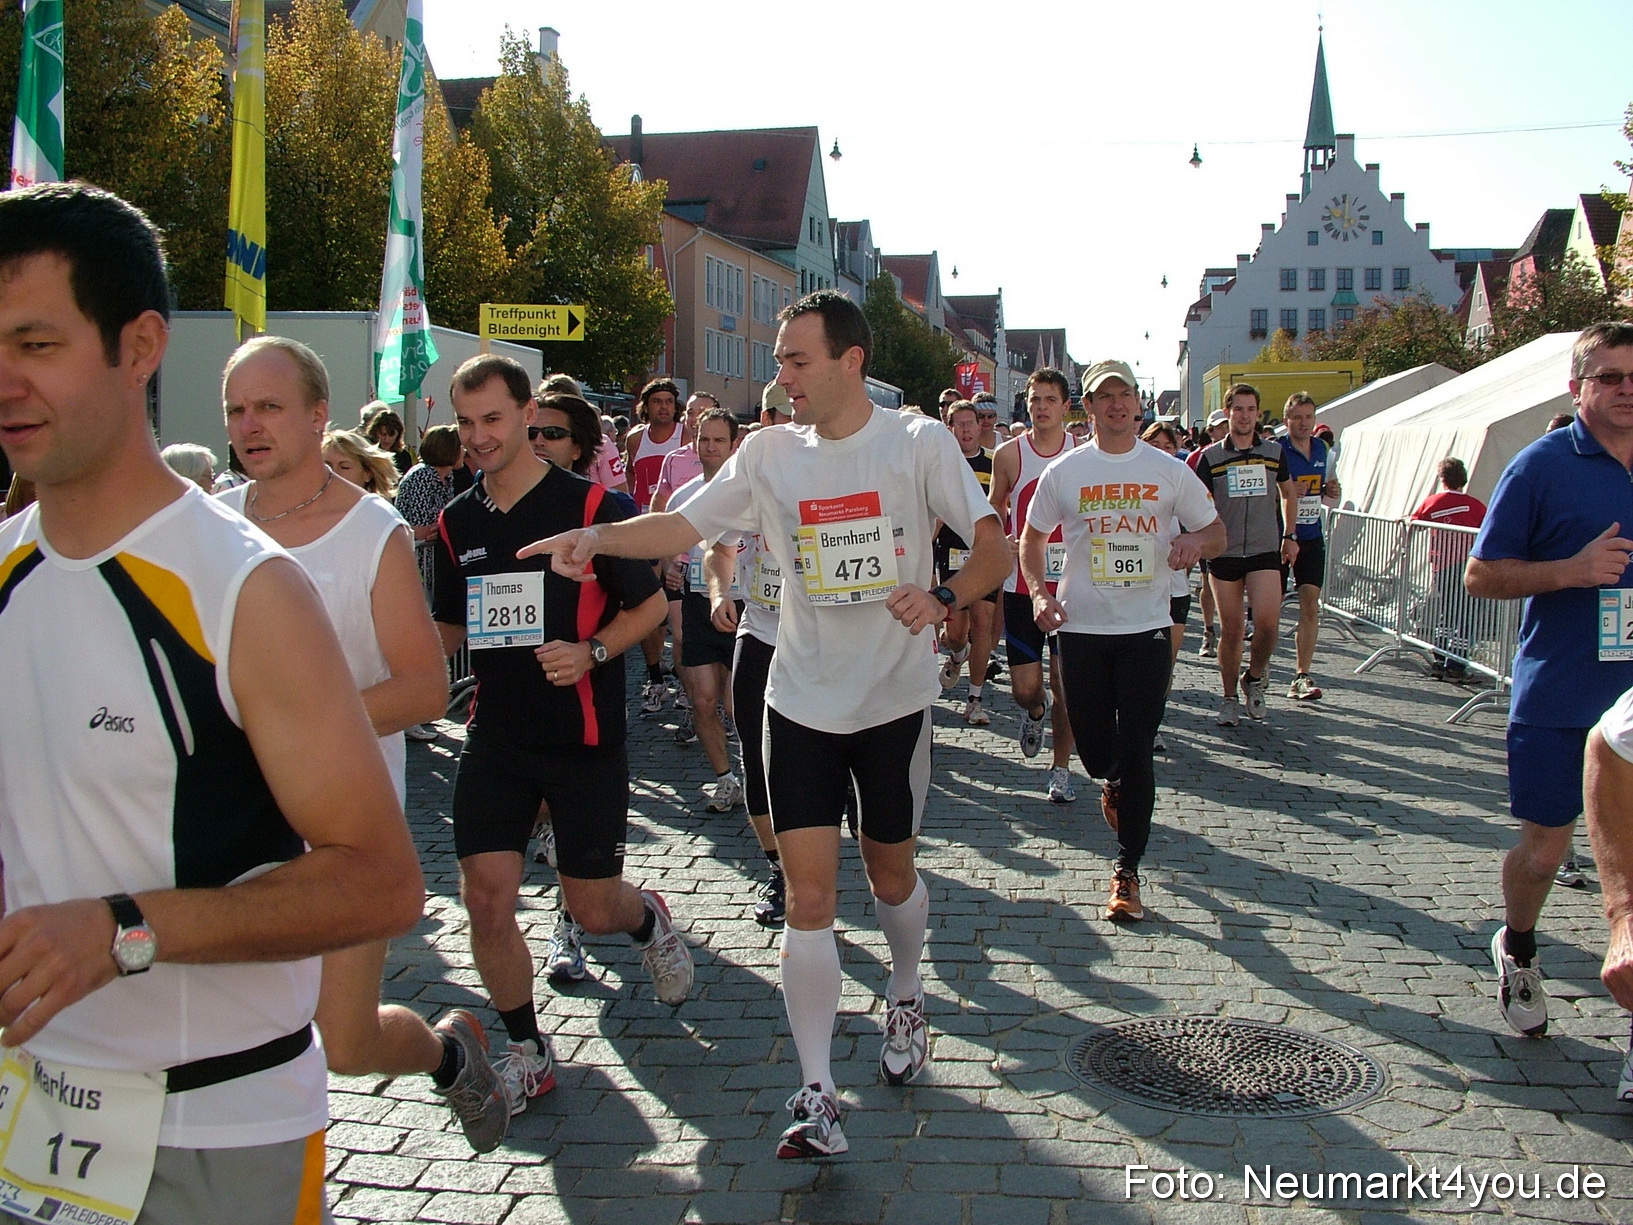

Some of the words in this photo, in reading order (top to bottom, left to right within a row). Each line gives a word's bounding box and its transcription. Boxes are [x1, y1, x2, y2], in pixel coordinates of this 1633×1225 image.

[488, 308, 556, 321] Treffpunkt
[488, 324, 560, 338] Bladenight
[1240, 478, 1264, 488] 2573
[1080, 483, 1159, 501] MERZ
[1084, 515, 1158, 533] TEAM
[821, 526, 880, 548] Bernhard
[1107, 542, 1139, 552] Thomas
[761, 563, 780, 577] Bernd
[835, 556, 882, 581] 473
[1114, 559, 1143, 573] 961
[486, 582, 523, 596] Thomas
[488, 605, 537, 627] 2818
[34, 1059, 102, 1110] Markus
[47, 1132, 102, 1179] 17
